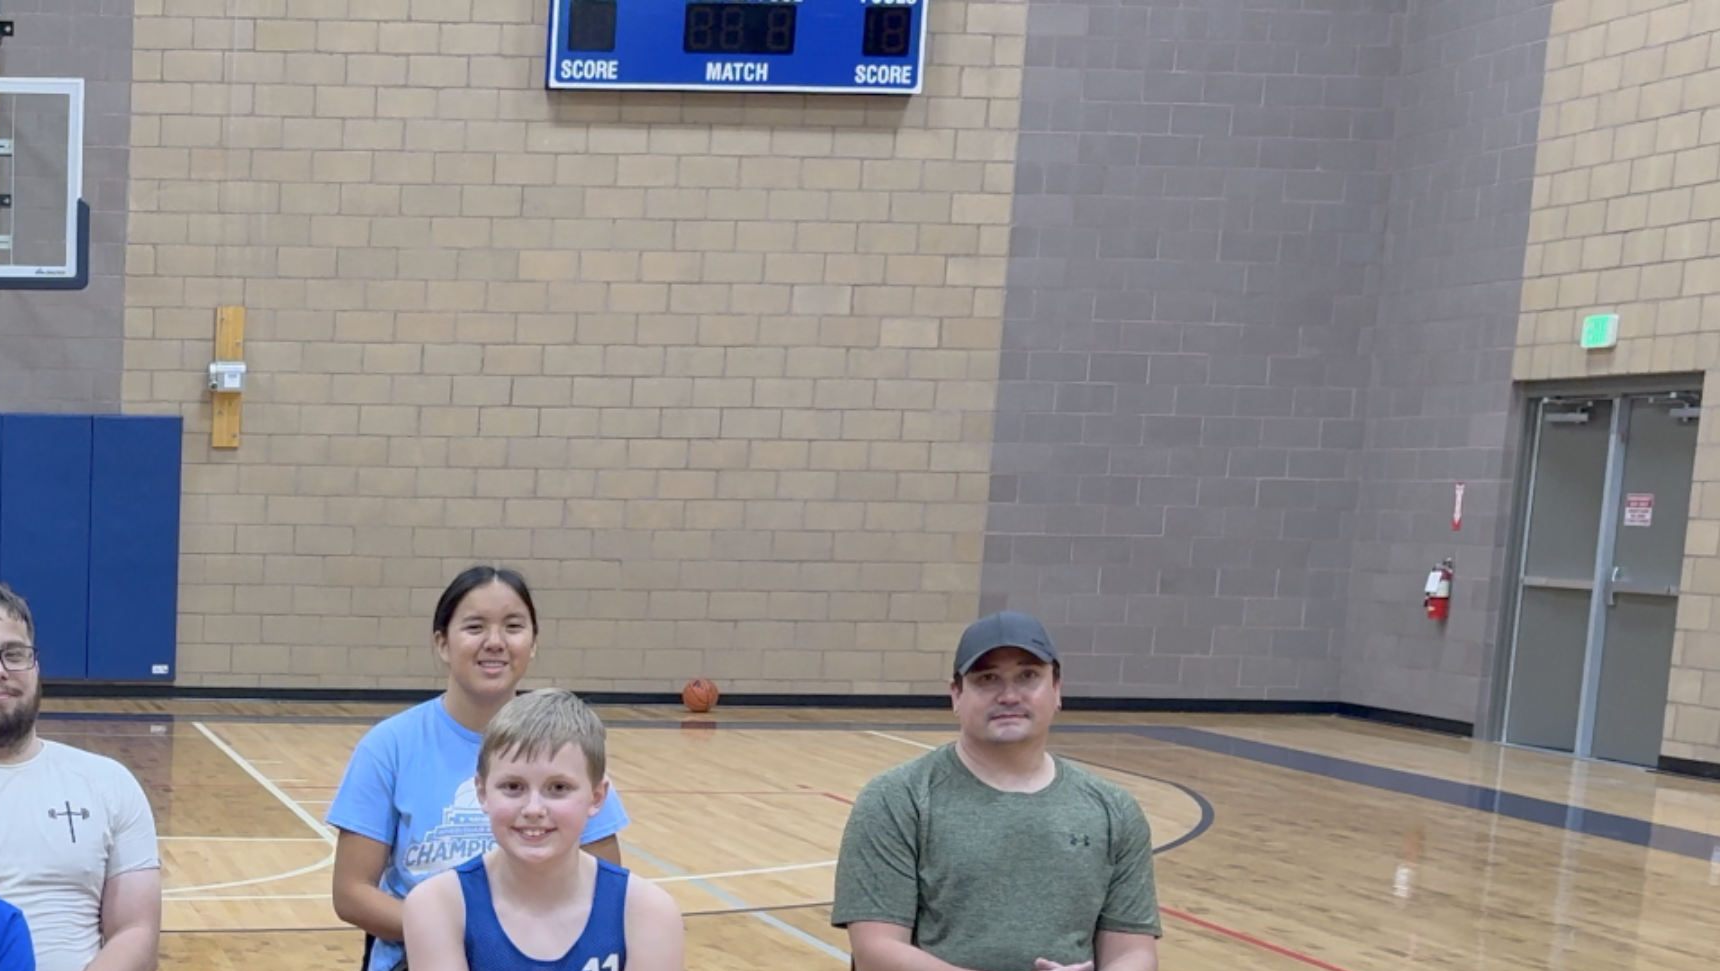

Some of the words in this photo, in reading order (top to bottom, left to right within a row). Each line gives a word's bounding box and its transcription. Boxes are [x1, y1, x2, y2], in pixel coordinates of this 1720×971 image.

[560, 59, 619, 80] SCORE
[705, 61, 769, 83] MATCH
[854, 64, 913, 85] SCORE
